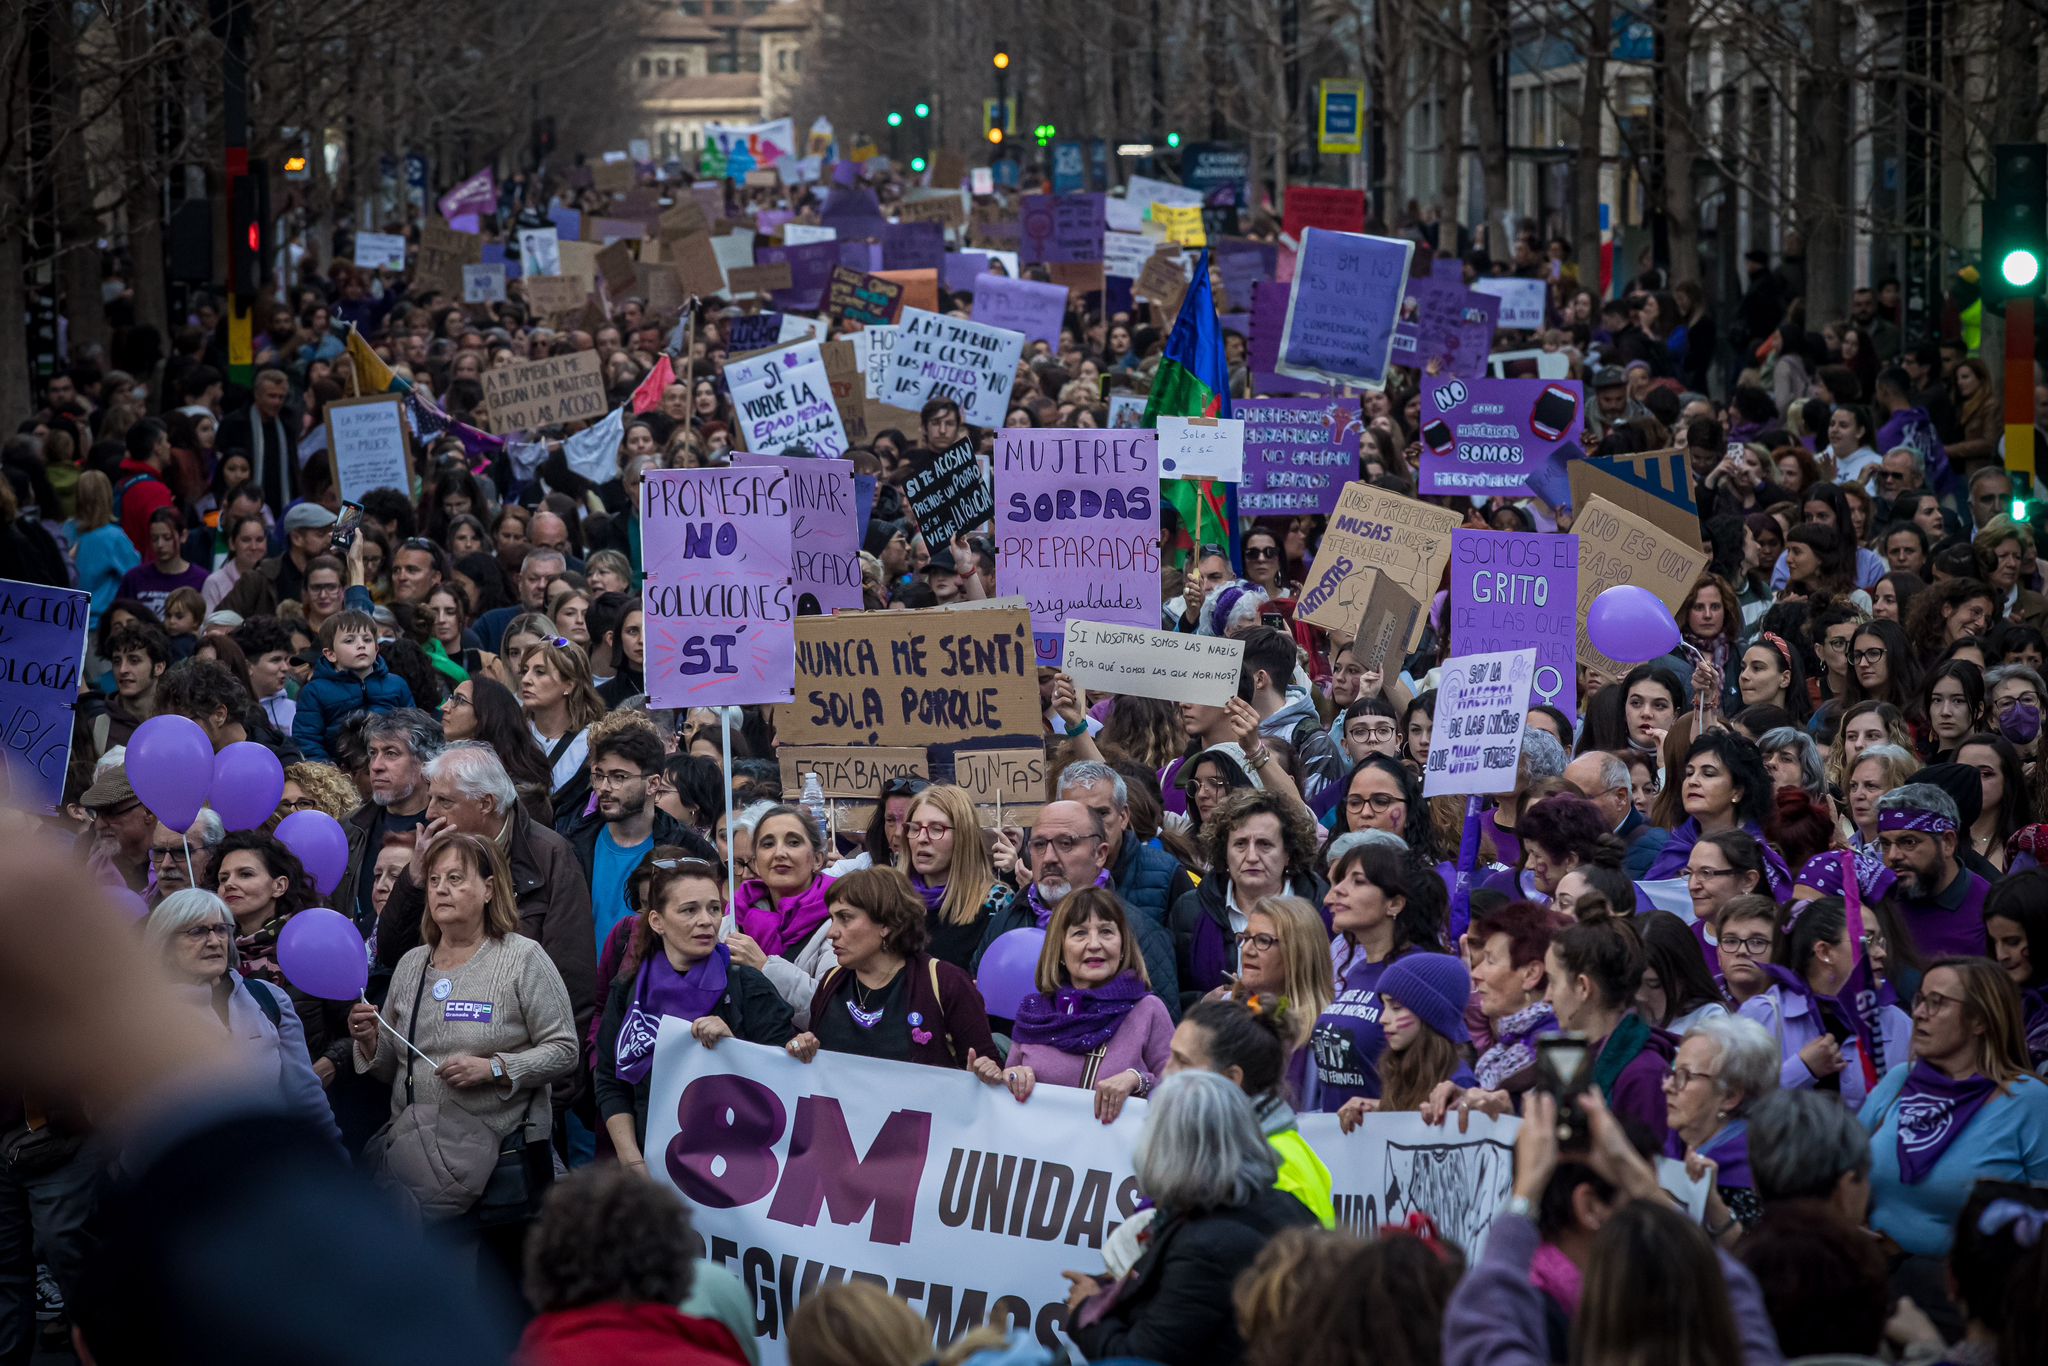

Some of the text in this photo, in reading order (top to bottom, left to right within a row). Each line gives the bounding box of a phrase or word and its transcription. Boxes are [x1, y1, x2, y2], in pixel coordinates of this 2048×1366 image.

[1337, 254, 1360, 272] 8M
[870, 330, 896, 350] HO
[907, 317, 920, 334] A
[897, 355, 920, 370] LAS
[921, 361, 978, 386] MUJERES
[914, 341, 993, 370] ME GUSTAN
[486, 375, 498, 393] A
[488, 371, 601, 410] GUSTAN LAS MUJERES
[763, 361, 783, 390] SI
[742, 381, 818, 422] VUELVE LA
[895, 376, 921, 396] LAS
[927, 381, 978, 411] ACOSO
[1433, 380, 1468, 413] NO
[506, 411, 526, 430] NO
[530, 405, 554, 426] LAS
[558, 391, 603, 418] ACOSO
[753, 401, 834, 439] EDAD MEDIA
[1234, 407, 1322, 424] QUISIERON
[1004, 438, 1148, 475] MUJERES
[1261, 448, 1285, 464] NO
[1457, 442, 1524, 464] SOMOS
[905, 442, 973, 498] SI TE ACOSAN
[647, 476, 789, 518] PROMESAS
[912, 464, 982, 518] PRENDE UN PORRO
[1007, 486, 1152, 522] SORDAS
[1239, 493, 1319, 509] SEMILLAS
[1340, 488, 1461, 535] NOS PREFIEREN
[926, 519, 958, 548] VIENE
[1394, 526, 1426, 548] NOS
[1582, 508, 1694, 584] NO ES UN
[1004, 535, 1160, 573] PREPARADAS
[1326, 534, 1400, 567] TEMEN
[1457, 537, 1577, 570] SOMOS EL
[1577, 540, 1633, 584] CASO
[647, 584, 791, 622] SOLUCIONES
[1297, 555, 1355, 620] ARTISTAS
[1472, 569, 1550, 608] GRITO
[0, 594, 85, 631] ACIÓN
[1457, 607, 1573, 637] DE LAS QUE
[679, 624, 739, 676] SÍ
[1067, 620, 1088, 643] SI
[1095, 630, 1146, 646] NOSOTRAS
[1151, 636, 1179, 649] SOMOS
[1184, 641, 1201, 653] LAS
[1456, 636, 1475, 656] YA
[794, 638, 880, 678] NUNCA
[890, 631, 928, 678] ME
[1098, 661, 1115, 672] QUÉ
[1120, 665, 1146, 675] SOMOS
[1152, 668, 1167, 677] LAS
[1170, 669, 1188, 679] QUE
[1467, 661, 1490, 684] SOY
[1489, 660, 1502, 682] LA
[808, 686, 1003, 730] SOLA PORQUE
[1448, 709, 1521, 739] DE LAS NIÑAS
[0, 705, 68, 779] IBLE
[795, 752, 1043, 795] ESTÁBAMOS JUNTAS
[1428, 748, 1450, 772] QUE
[632, 1018, 657, 1048] UGT
[1328, 1070, 1365, 1086] FEMINISTA
[665, 1074, 932, 1246] 8M
